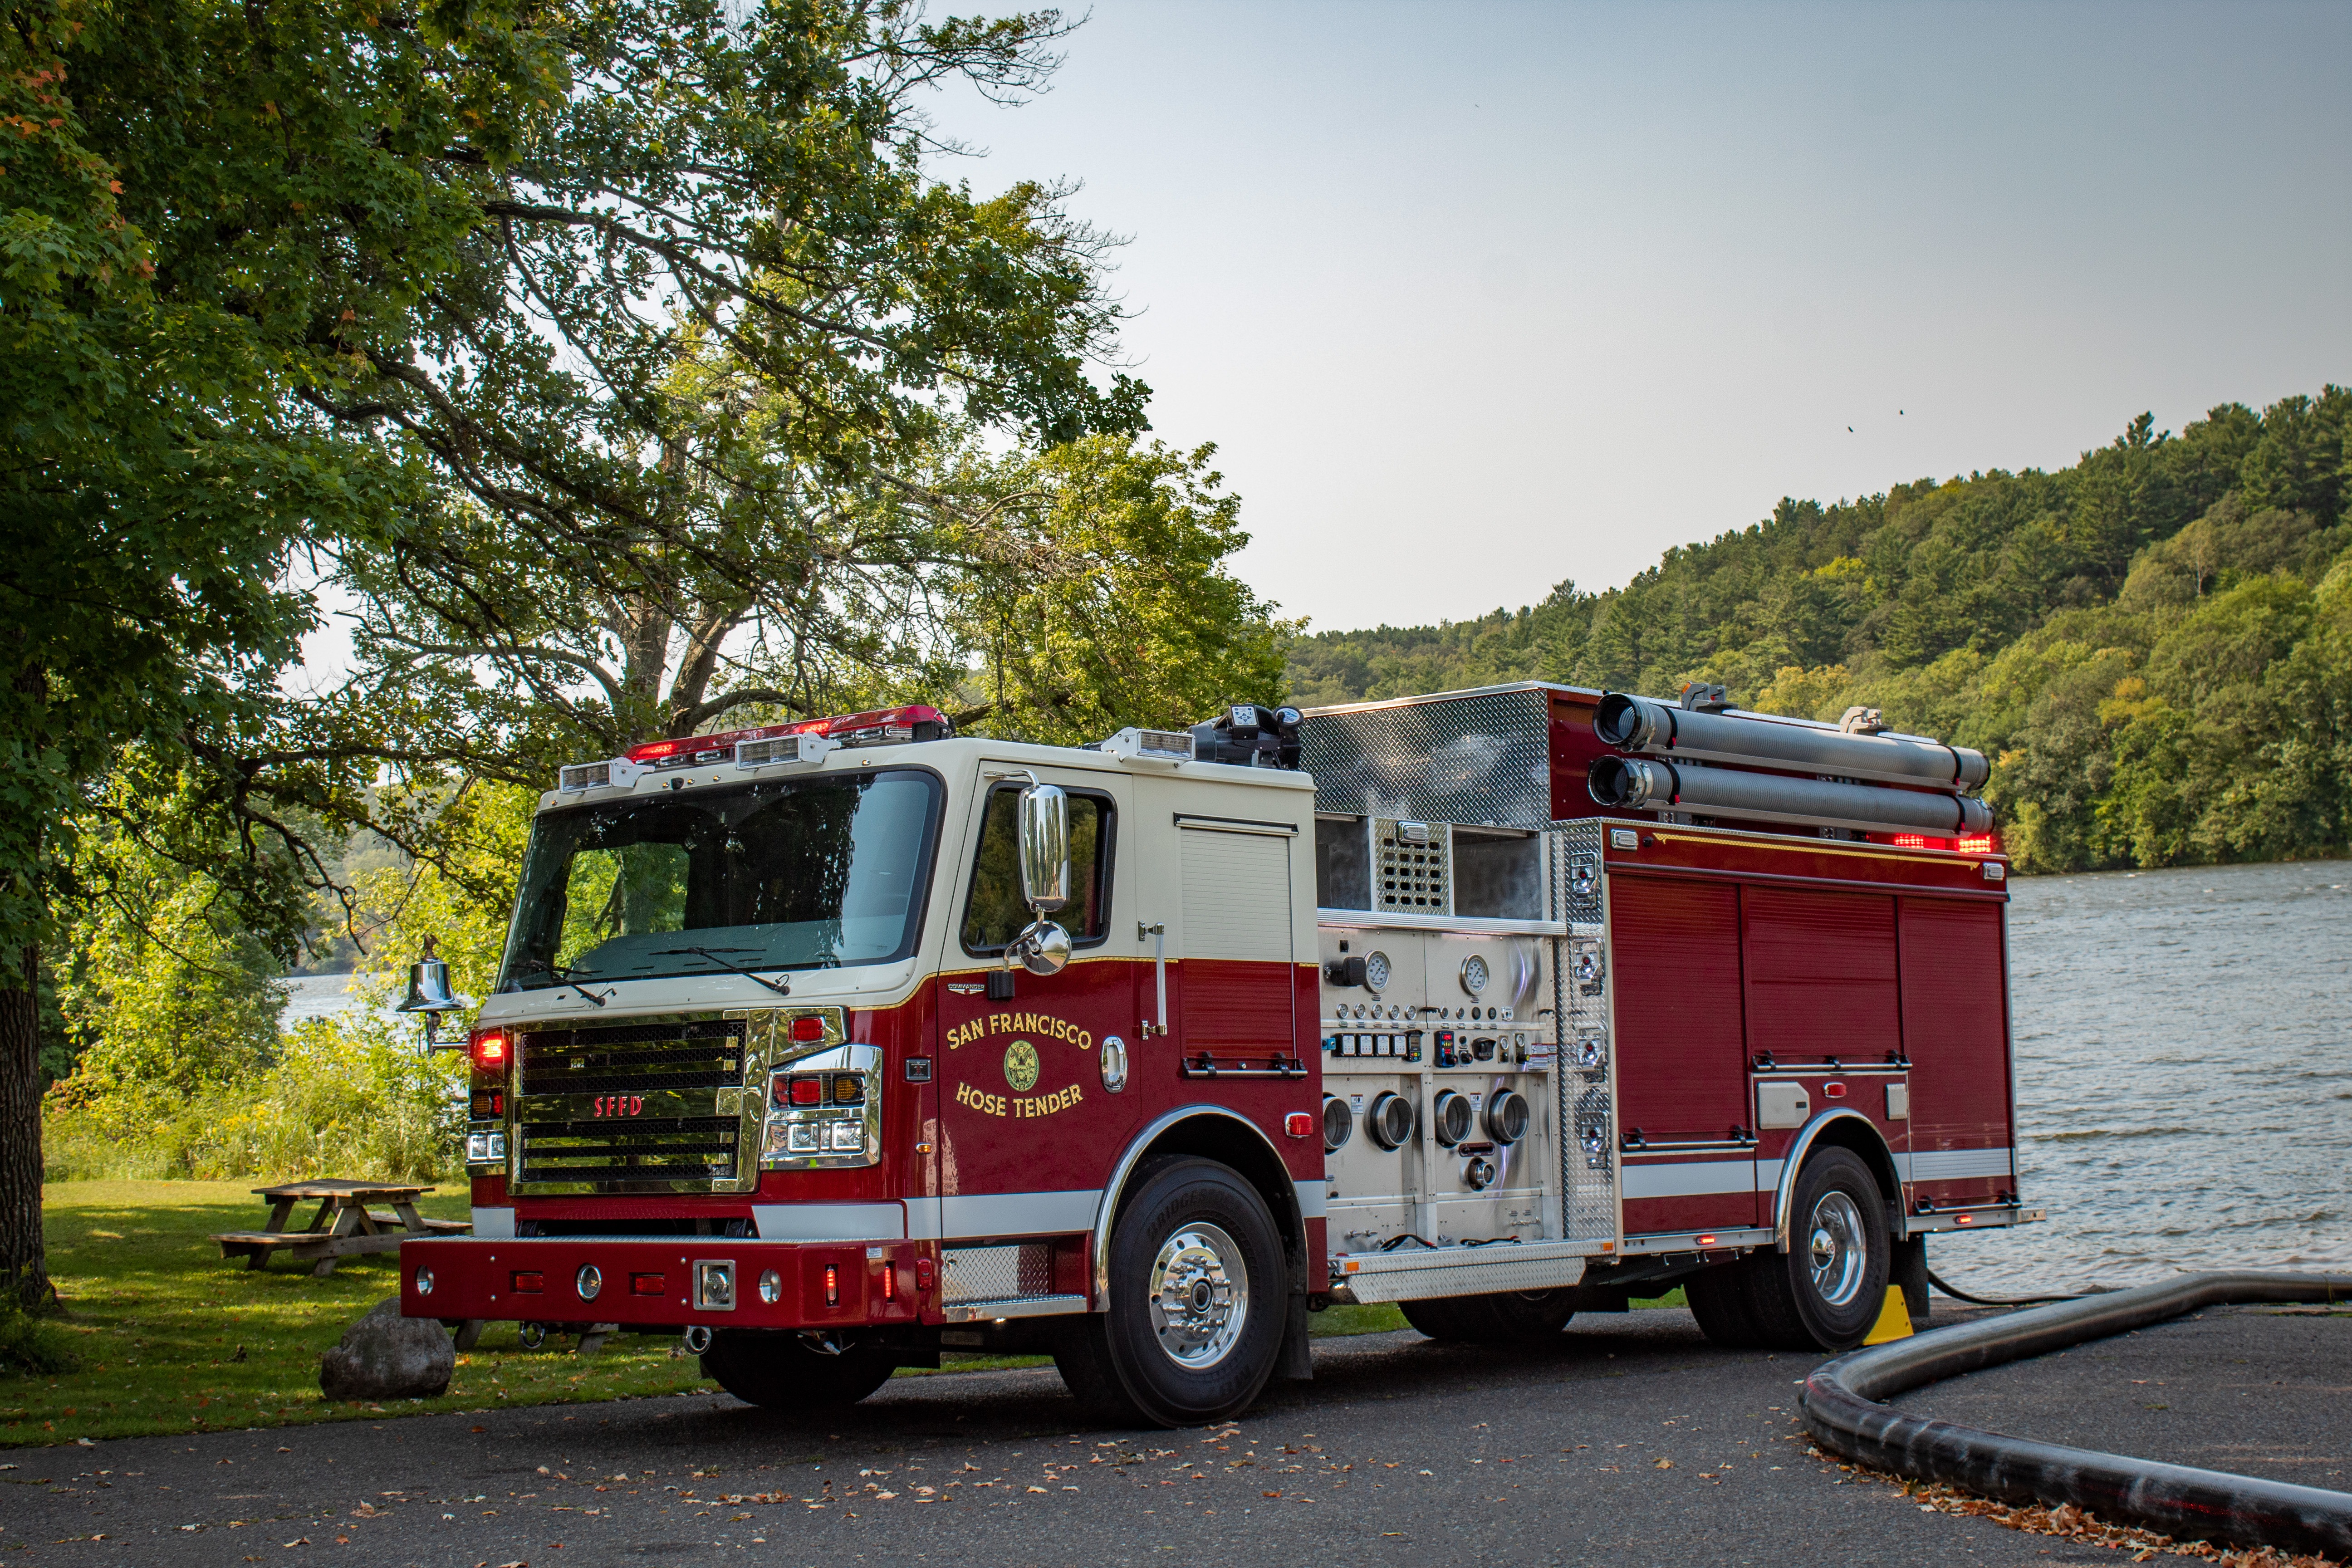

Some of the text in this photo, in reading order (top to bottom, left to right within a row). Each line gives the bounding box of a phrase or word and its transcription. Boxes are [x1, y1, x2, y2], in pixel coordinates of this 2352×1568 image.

[947, 1012, 1092, 1050] SAN FRANCISCO
[594, 1096, 642, 1117] SFFD
[956, 1082, 1084, 1117] HOSE TENDER
